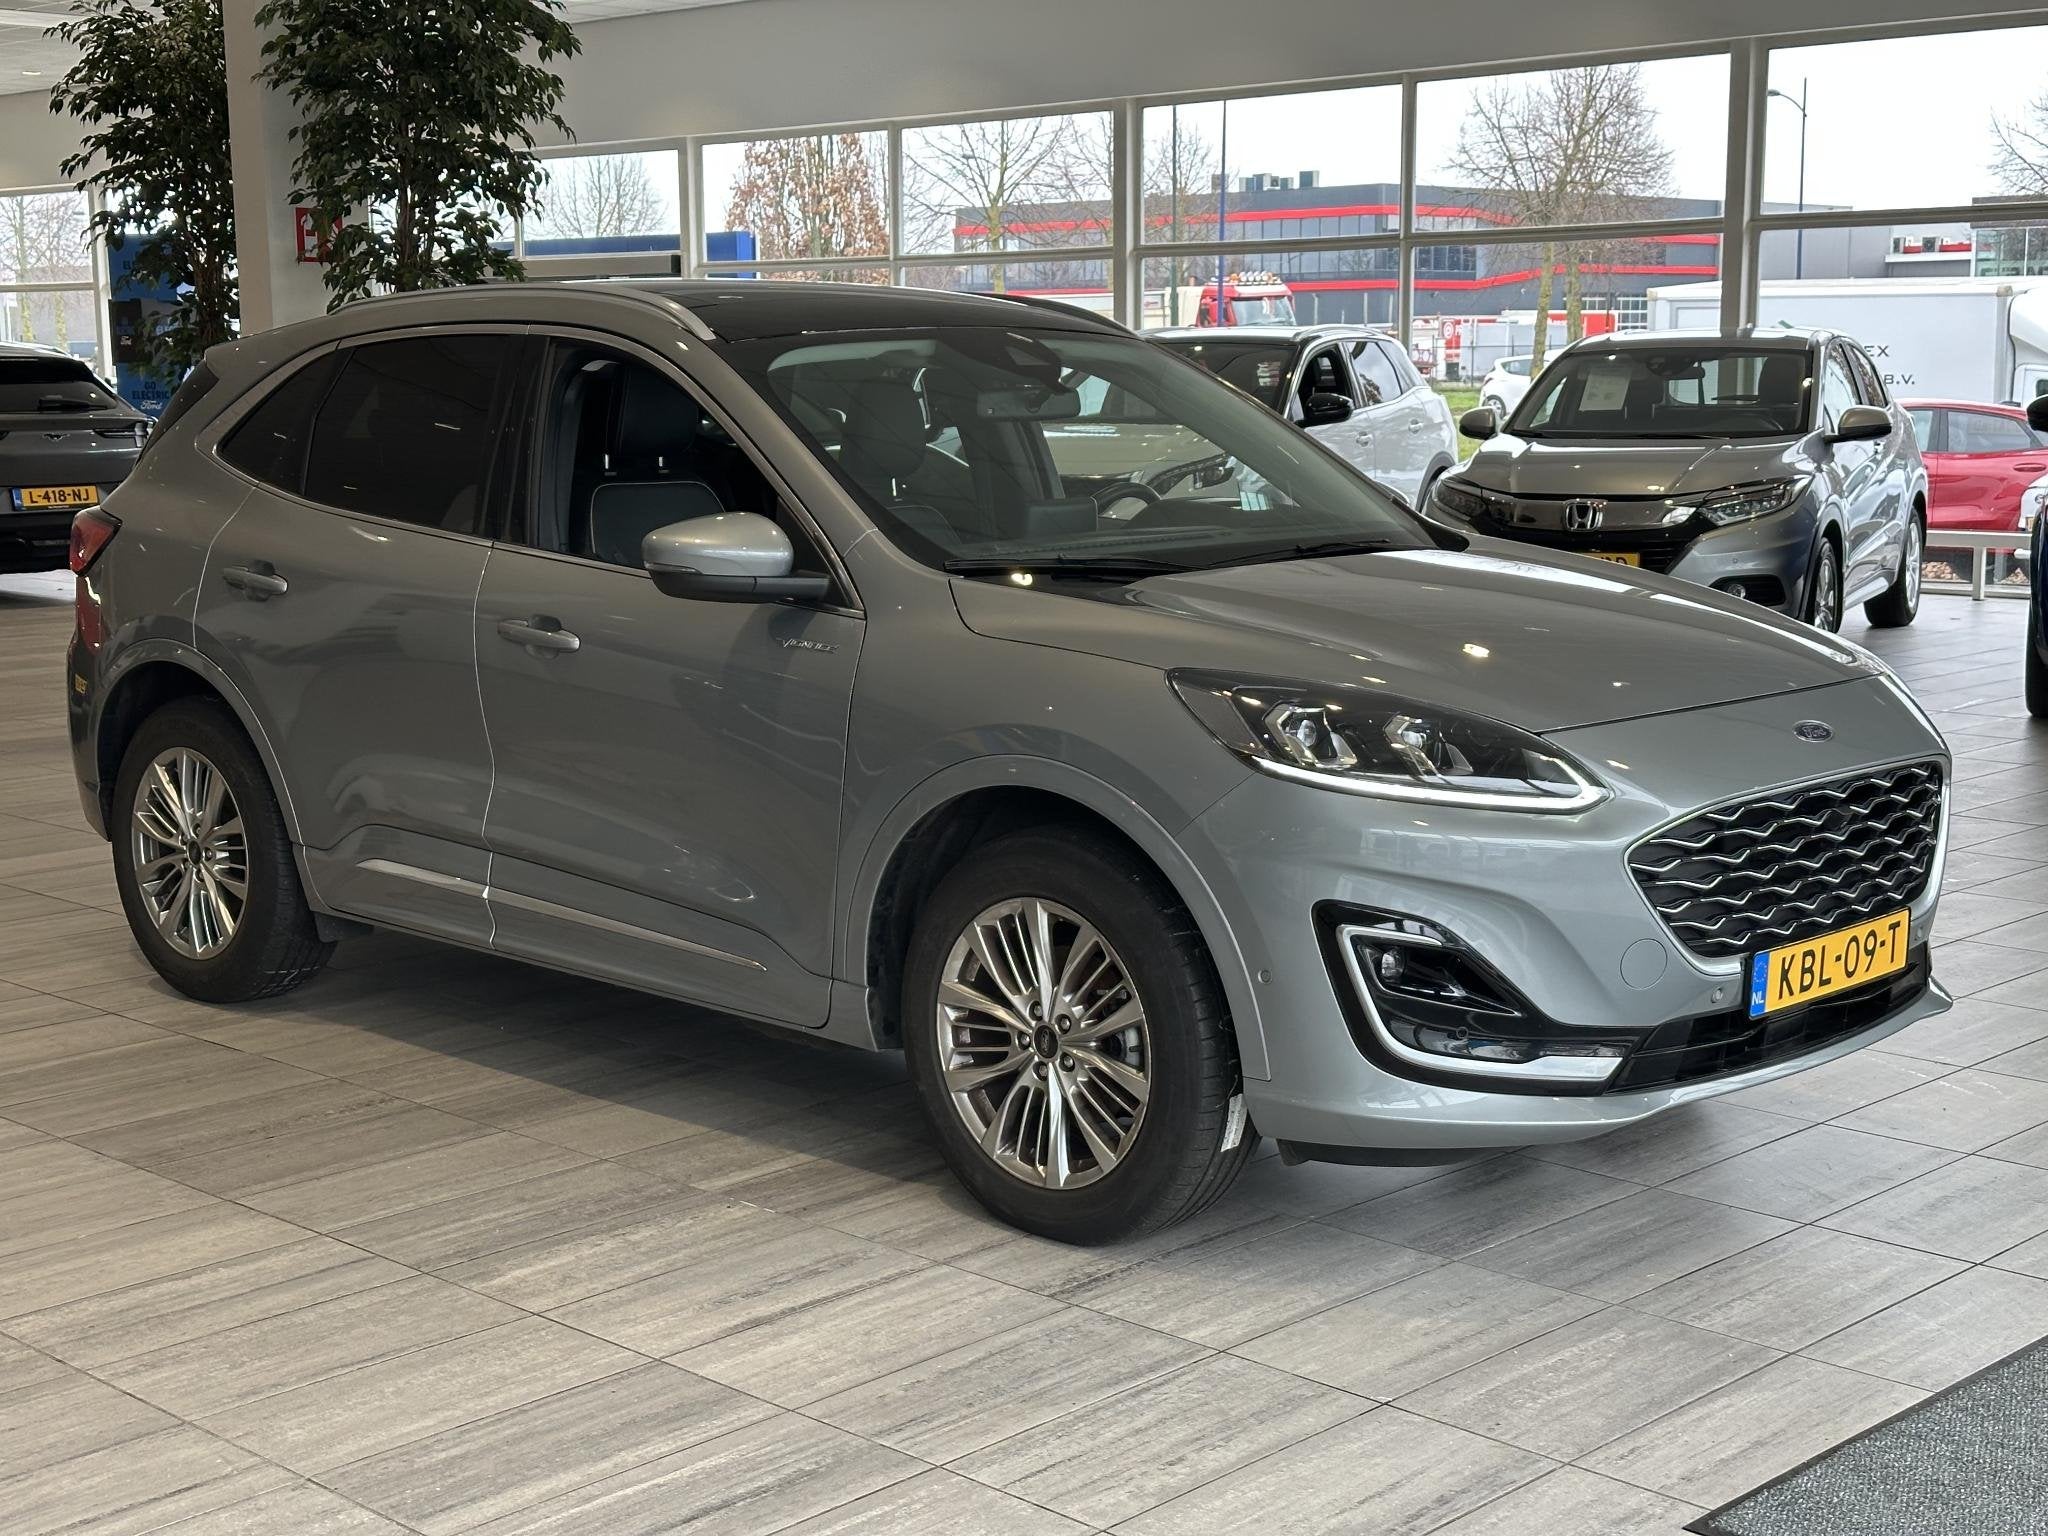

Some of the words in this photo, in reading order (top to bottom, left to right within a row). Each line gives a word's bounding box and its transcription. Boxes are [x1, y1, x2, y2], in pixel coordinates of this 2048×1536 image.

[1883, 374, 1916, 385] B.V.
[132, 390, 171, 400] ELECTRIC
[140, 400, 163, 410] Ford
[28, 488, 91, 505] L-418-NJ
[1777, 919, 1902, 1001] KBL-09-T
[1751, 990, 1765, 1006] NL
